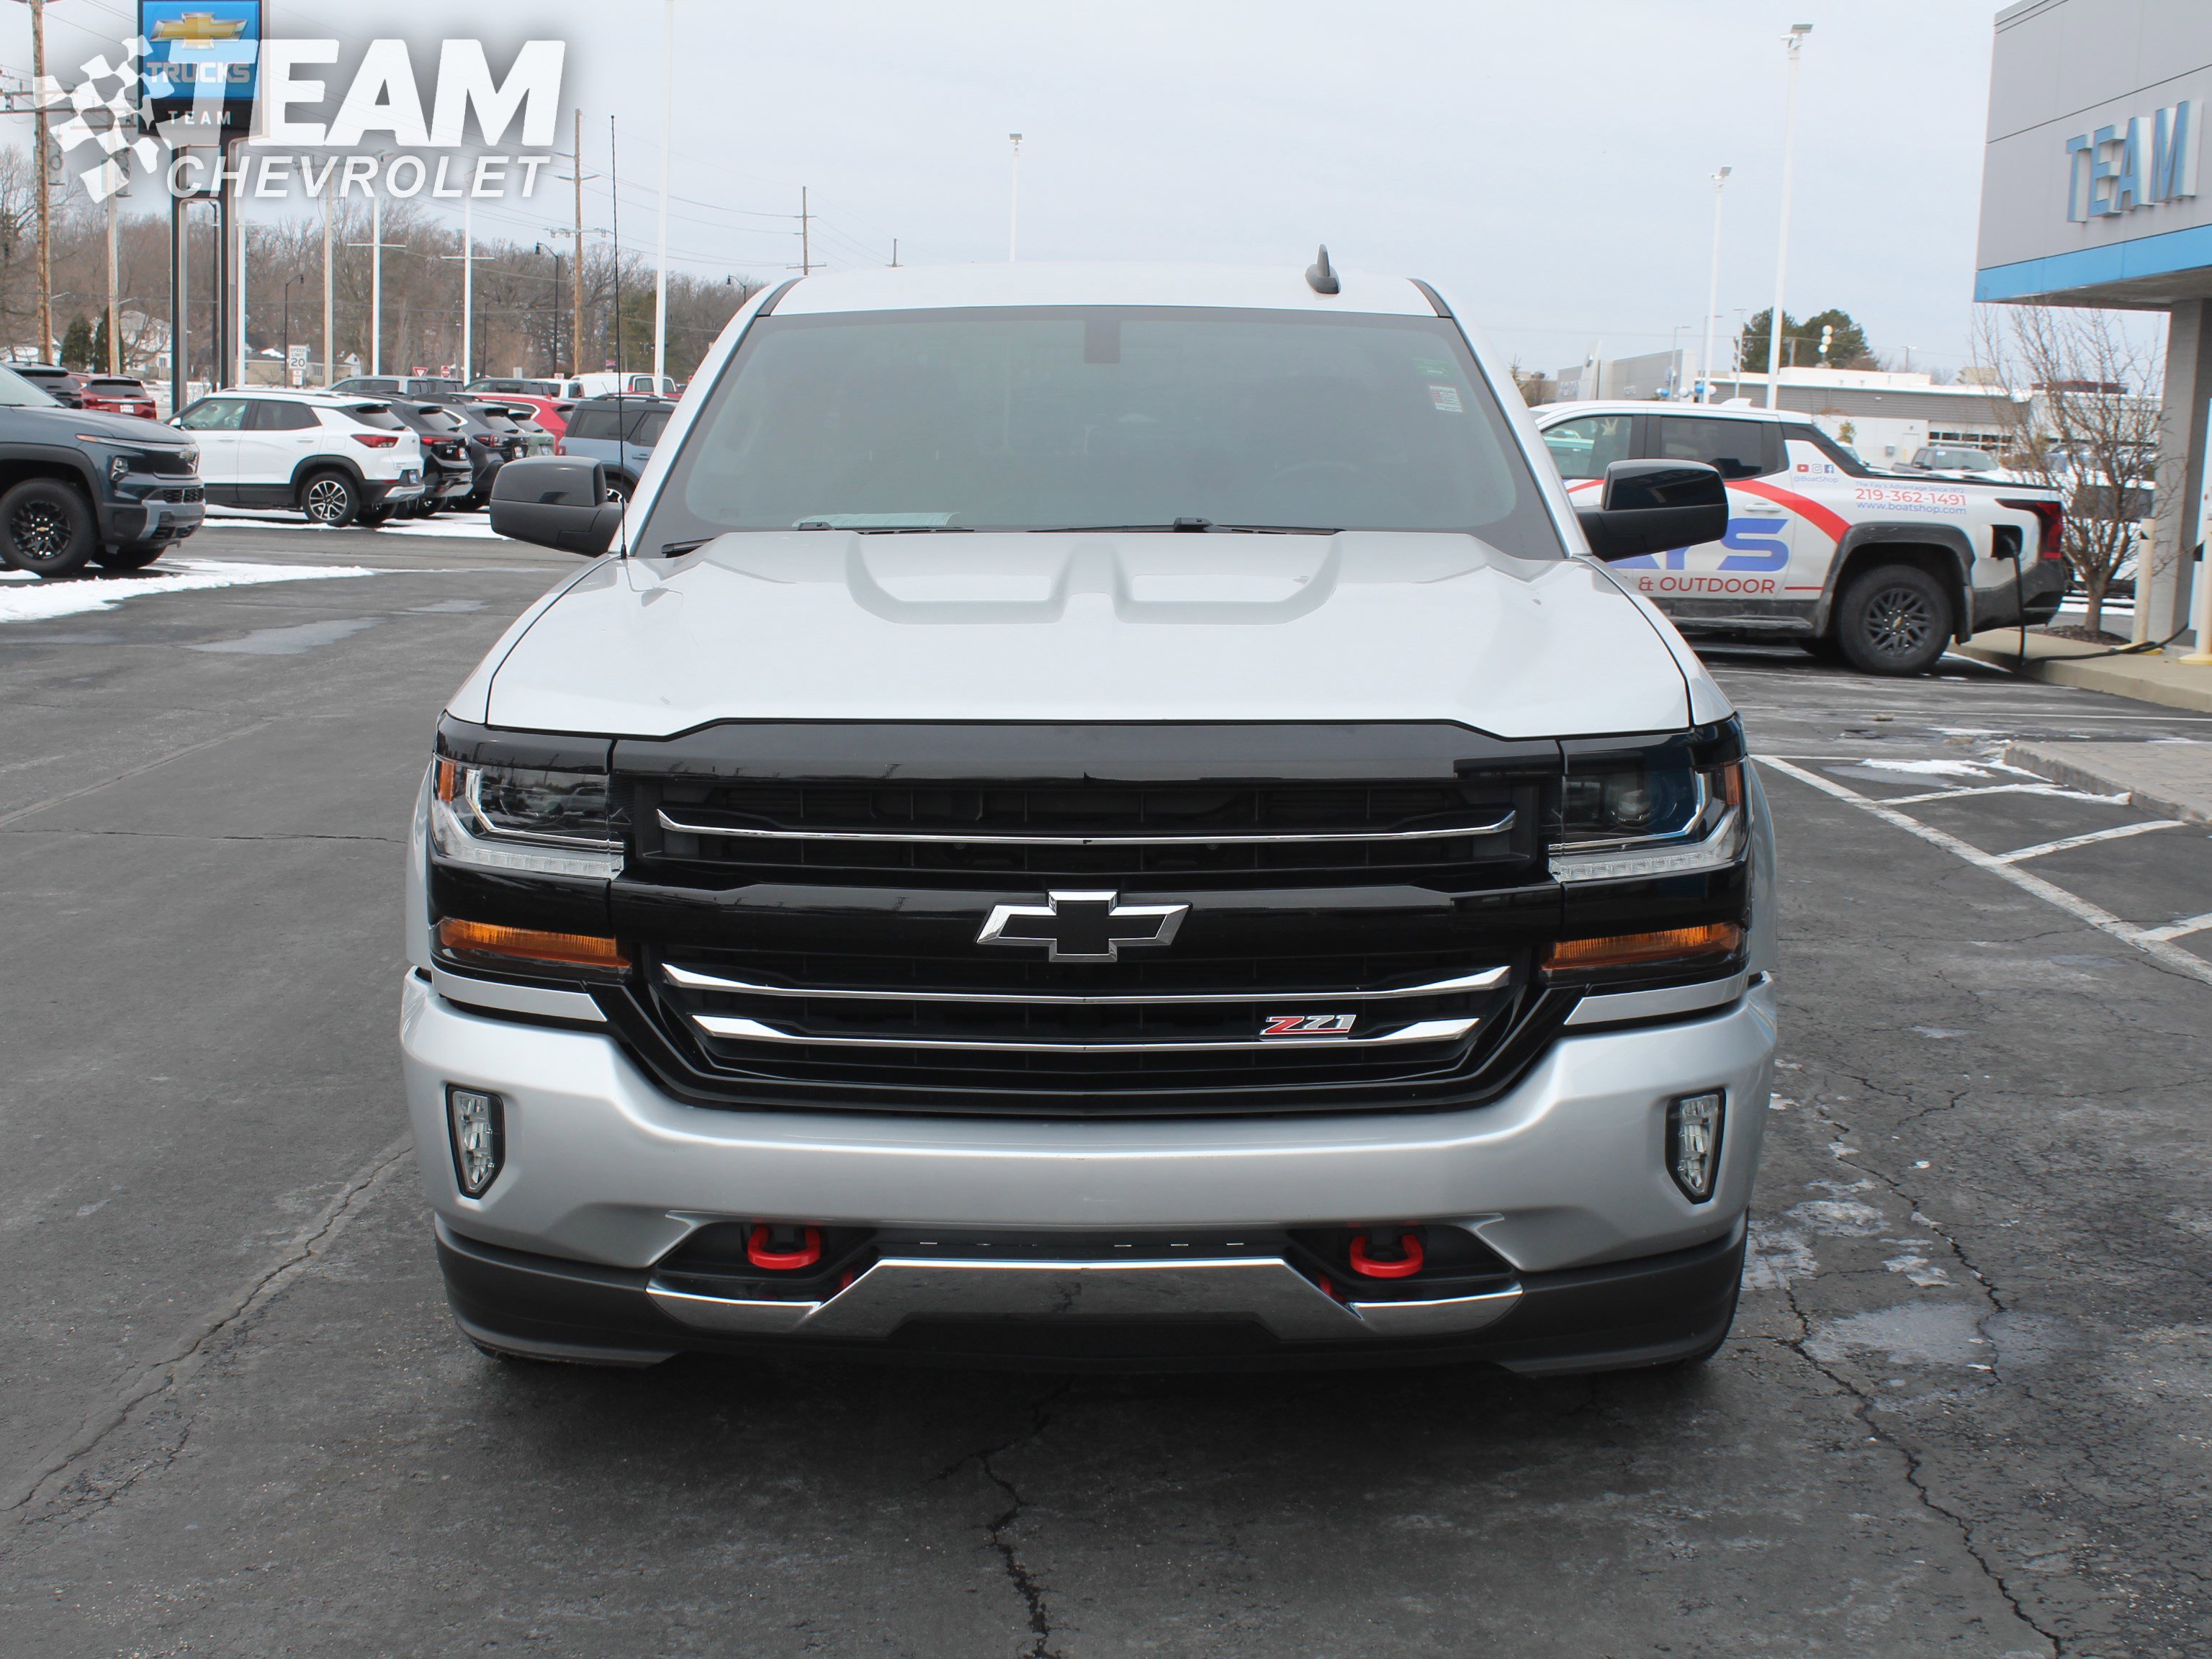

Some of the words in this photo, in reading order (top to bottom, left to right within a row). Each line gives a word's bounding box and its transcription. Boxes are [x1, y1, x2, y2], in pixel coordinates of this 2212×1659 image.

[146, 62, 251, 84] TRUCKS
[168, 111, 231, 125] TEAM
[2066, 100, 2203, 223] TEAM
[291, 357, 305, 367] 20
[1855, 488, 1966, 506] 219-362-1491
[1856, 501, 1967, 514] www.boatshop.com
[1638, 576, 1654, 591] &
[1659, 577, 1776, 593] OUTDOOR
[1259, 1014, 1357, 1035] Z71
